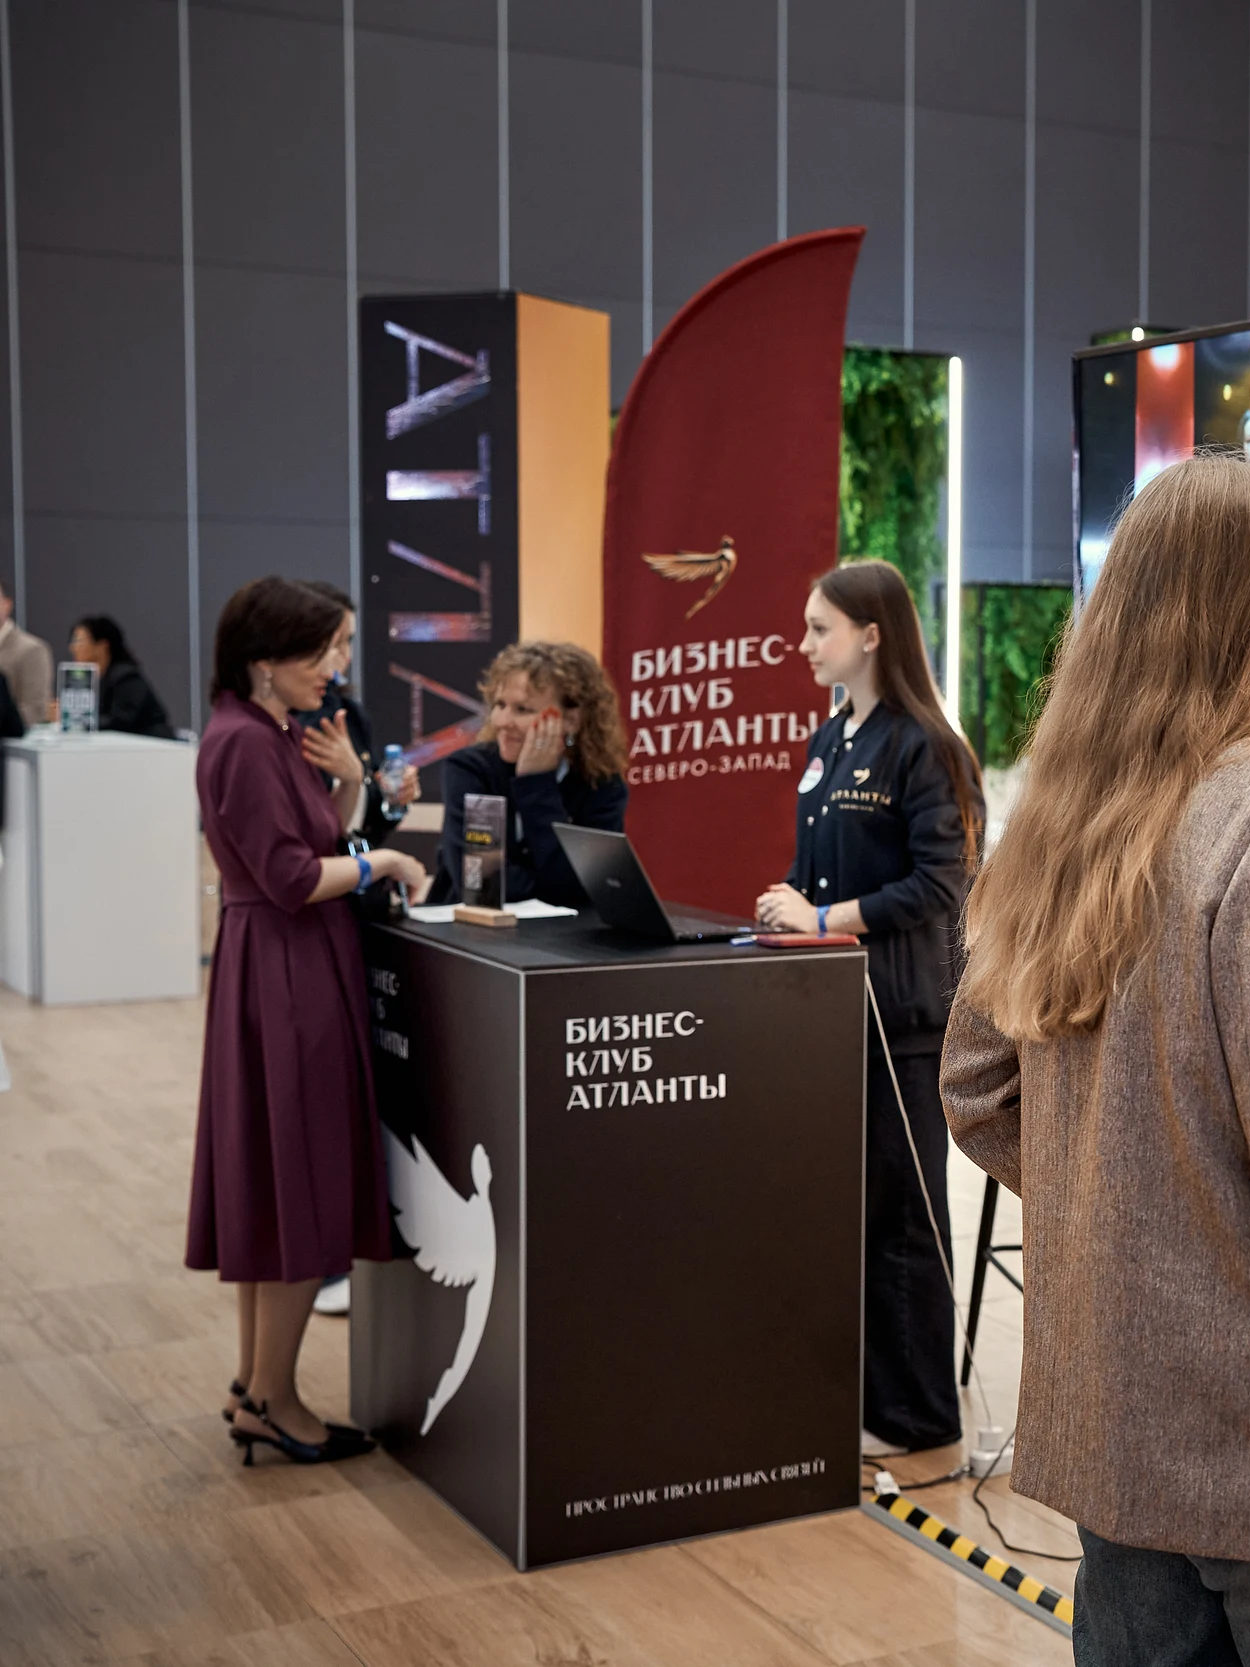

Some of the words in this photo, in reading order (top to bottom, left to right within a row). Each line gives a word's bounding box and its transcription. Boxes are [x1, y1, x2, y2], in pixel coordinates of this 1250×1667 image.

[384, 319, 492, 769] АТЛА
[630, 634, 794, 682] БИЗНЕС-
[629, 676, 734, 720] КЛУБ
[628, 710, 819, 759] АТЛАНТЫ
[626, 751, 791, 785] СЕВЕРО-ЗАПАД
[565, 1010, 704, 1045] БИЗНЕС-
[565, 1046, 653, 1078] КЛУБ
[566, 1073, 727, 1112] АТЛАНТЫ
